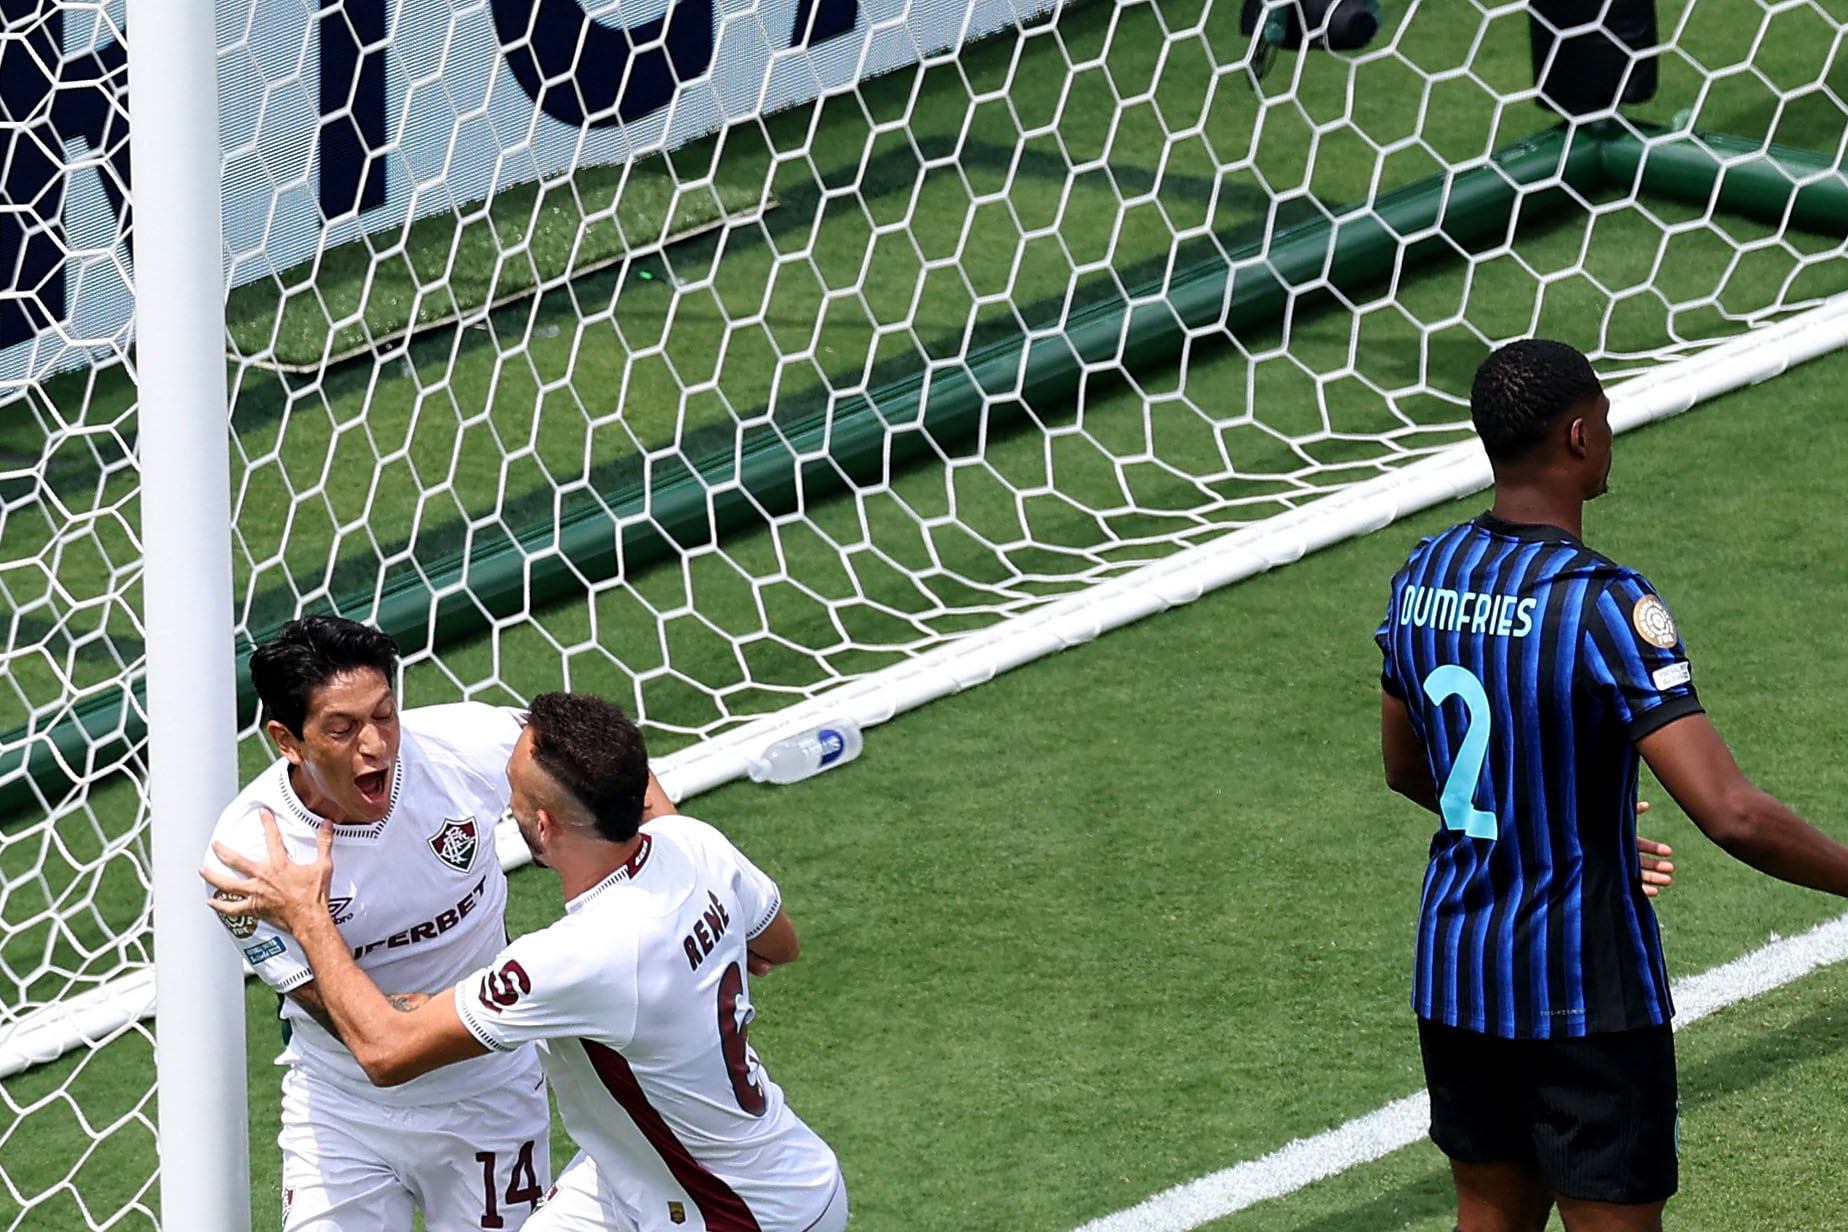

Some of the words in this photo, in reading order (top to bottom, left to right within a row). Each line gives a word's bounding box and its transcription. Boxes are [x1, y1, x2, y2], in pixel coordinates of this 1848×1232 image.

[1400, 584, 1537, 638] DUMFRIES
[1423, 664, 1498, 841] 2
[475, 1140, 544, 1229] 14
